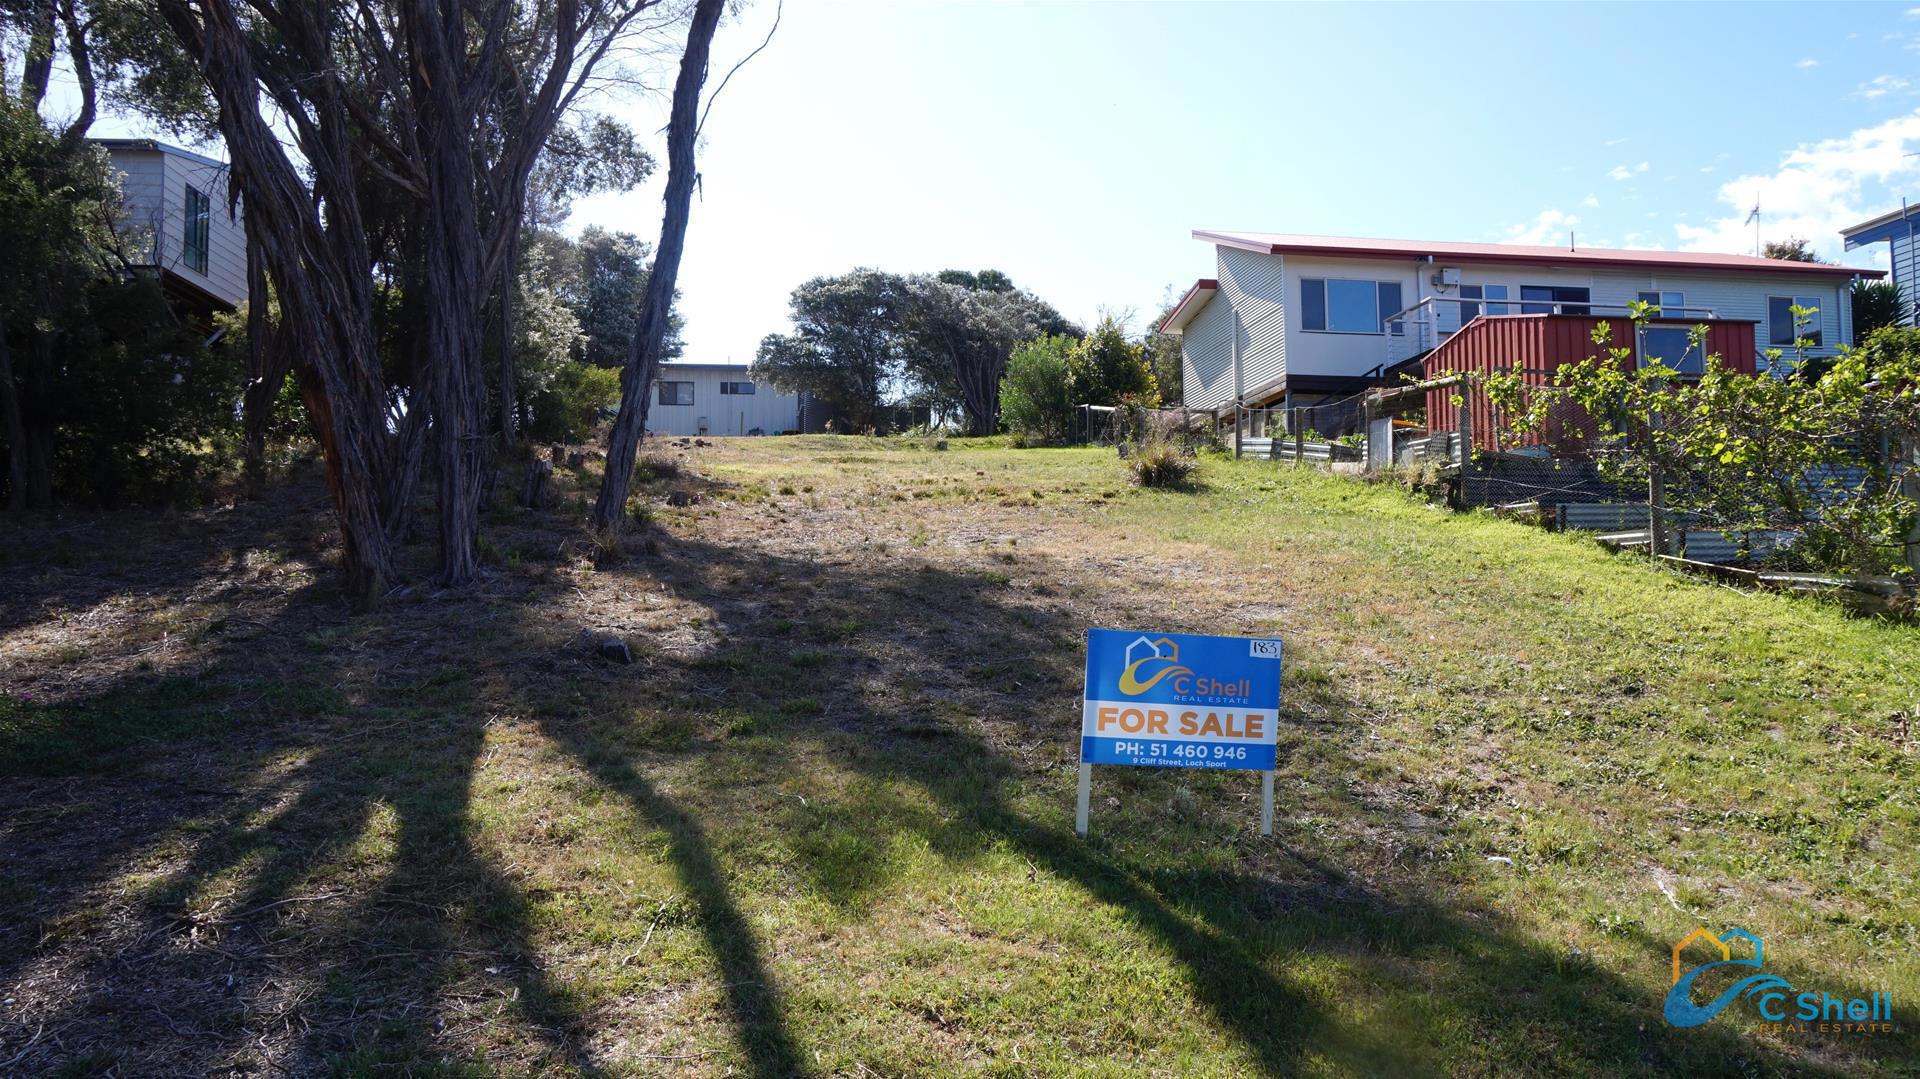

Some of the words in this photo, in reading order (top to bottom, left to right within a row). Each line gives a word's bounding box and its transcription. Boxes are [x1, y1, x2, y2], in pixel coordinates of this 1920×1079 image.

[1174, 677, 1189, 694] C
[1196, 679, 1250, 697] Shell
[1097, 707, 1169, 734] FOR
[1179, 711, 1264, 738] SALE
[1115, 742, 1144, 755] PH:
[1150, 744, 1166, 756] 51
[1173, 745, 1207, 758] 460
[1214, 746, 1246, 759] 946
[1159, 758, 1183, 767] Street,
[1185, 759, 1204, 767] Loch
[1206, 760, 1227, 768] Sport
